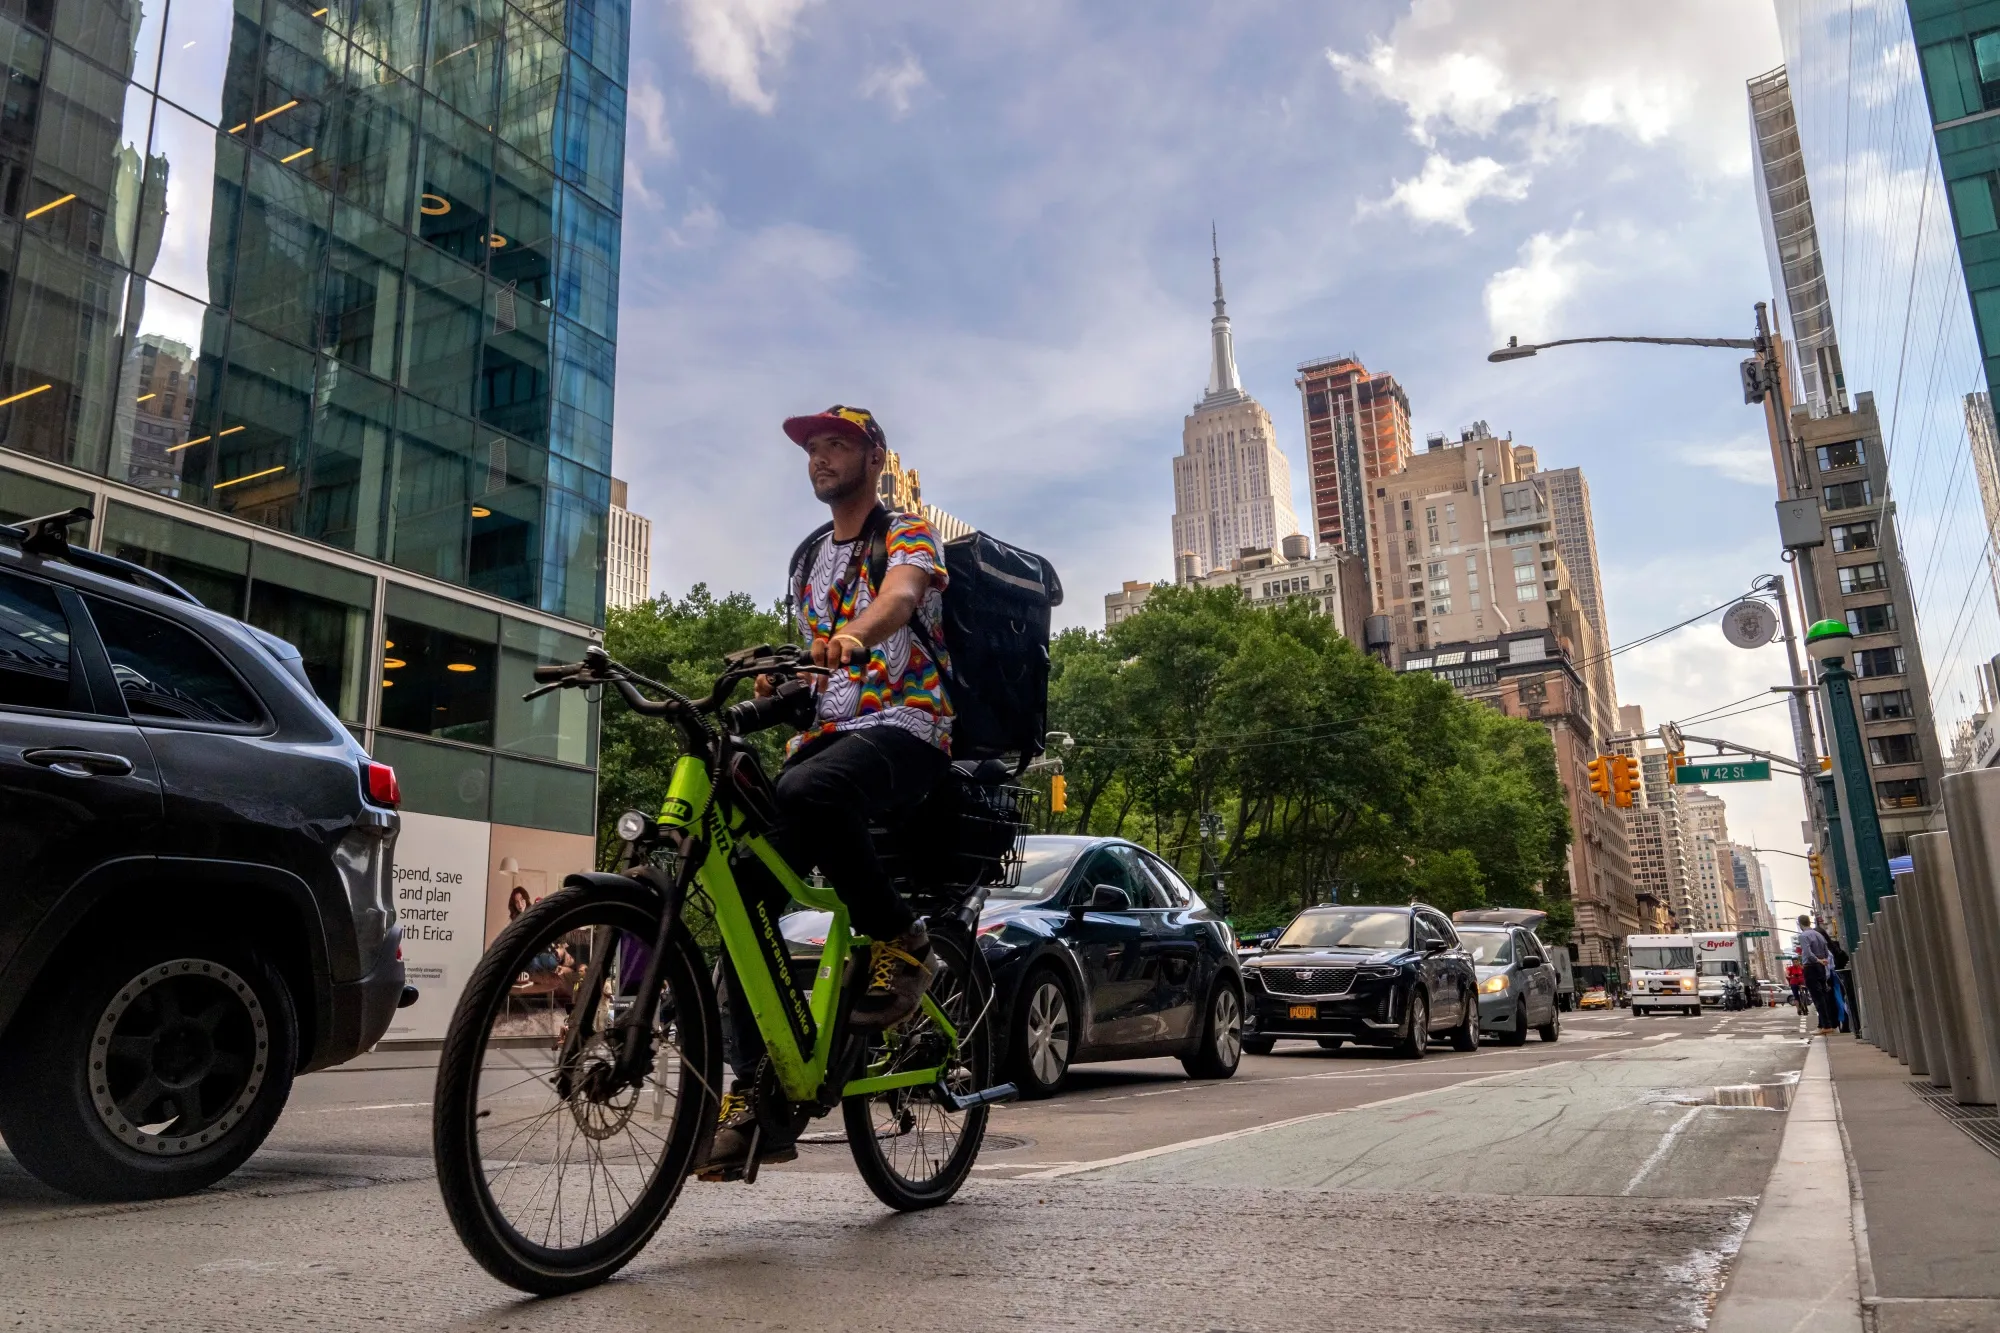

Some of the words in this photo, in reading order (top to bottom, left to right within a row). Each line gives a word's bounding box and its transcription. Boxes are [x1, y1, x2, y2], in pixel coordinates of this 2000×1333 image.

[1701, 768, 1710, 780] W
[1714, 767, 1729, 779] 42
[1733, 766, 1745, 779] St
[436, 871, 463, 885] save
[399, 885, 423, 901] and
[425, 886, 451, 905] plan
[400, 908, 449, 922] smarter
[756, 900, 791, 987] long-range
[1706, 940, 1735, 949] Ryder
[789, 988, 810, 1035] e-bike
